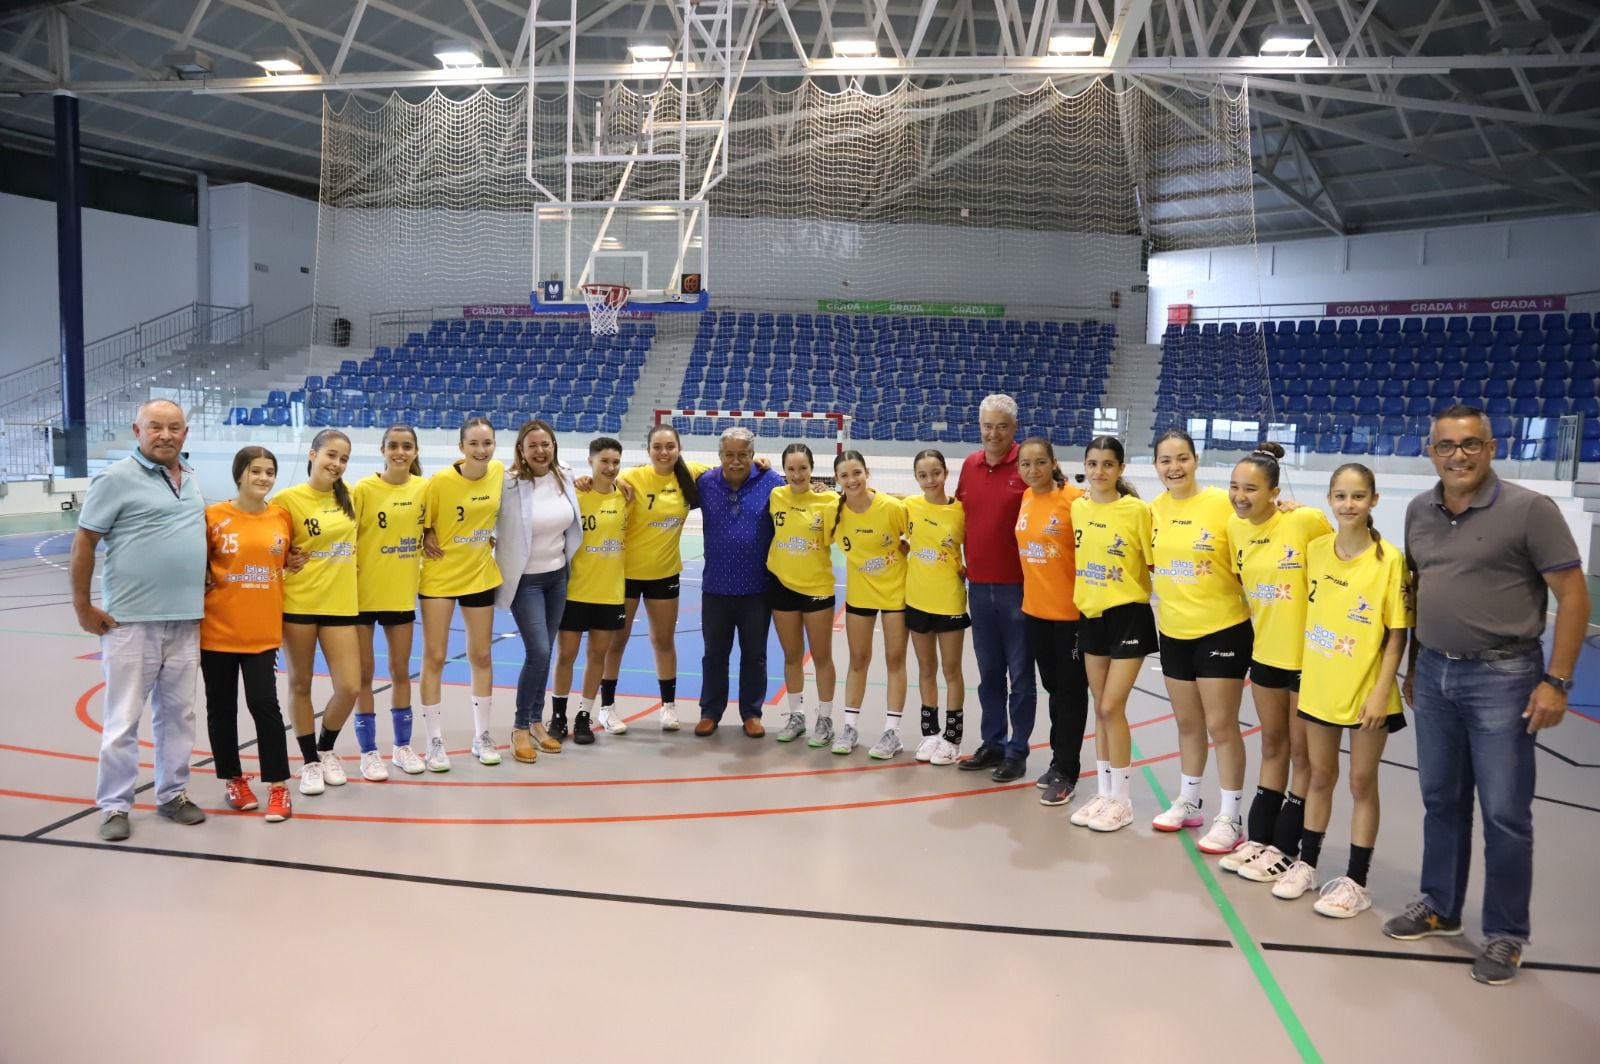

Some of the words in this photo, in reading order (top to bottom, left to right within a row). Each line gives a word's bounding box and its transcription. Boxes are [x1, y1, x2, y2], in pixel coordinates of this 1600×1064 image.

[826, 303, 861, 312] GRADA
[889, 303, 924, 313] GRADA
[952, 305, 986, 314] GRADA
[1336, 305, 1376, 315] GRADA
[1380, 304, 1388, 313] H
[1410, 302, 1454, 312] GRADA
[1458, 302, 1467, 310] H
[1491, 299, 1537, 310] GRADA
[1544, 298, 1553, 308] H
[471, 306, 506, 316] GRADA
[646, 494, 656, 510] 7
[456, 505, 465, 522] 3
[774, 511, 787, 527] 15
[377, 511, 388, 529] 8
[580, 514, 597, 532] 20
[303, 517, 322, 538] 18
[221, 532, 240, 554] 25
[400, 537, 417, 545] Isla
[842, 536, 852, 552] 9
[380, 546, 417, 554] Canaria
[1087, 561, 1106, 572] Islas
[1075, 569, 1106, 580] anarias
